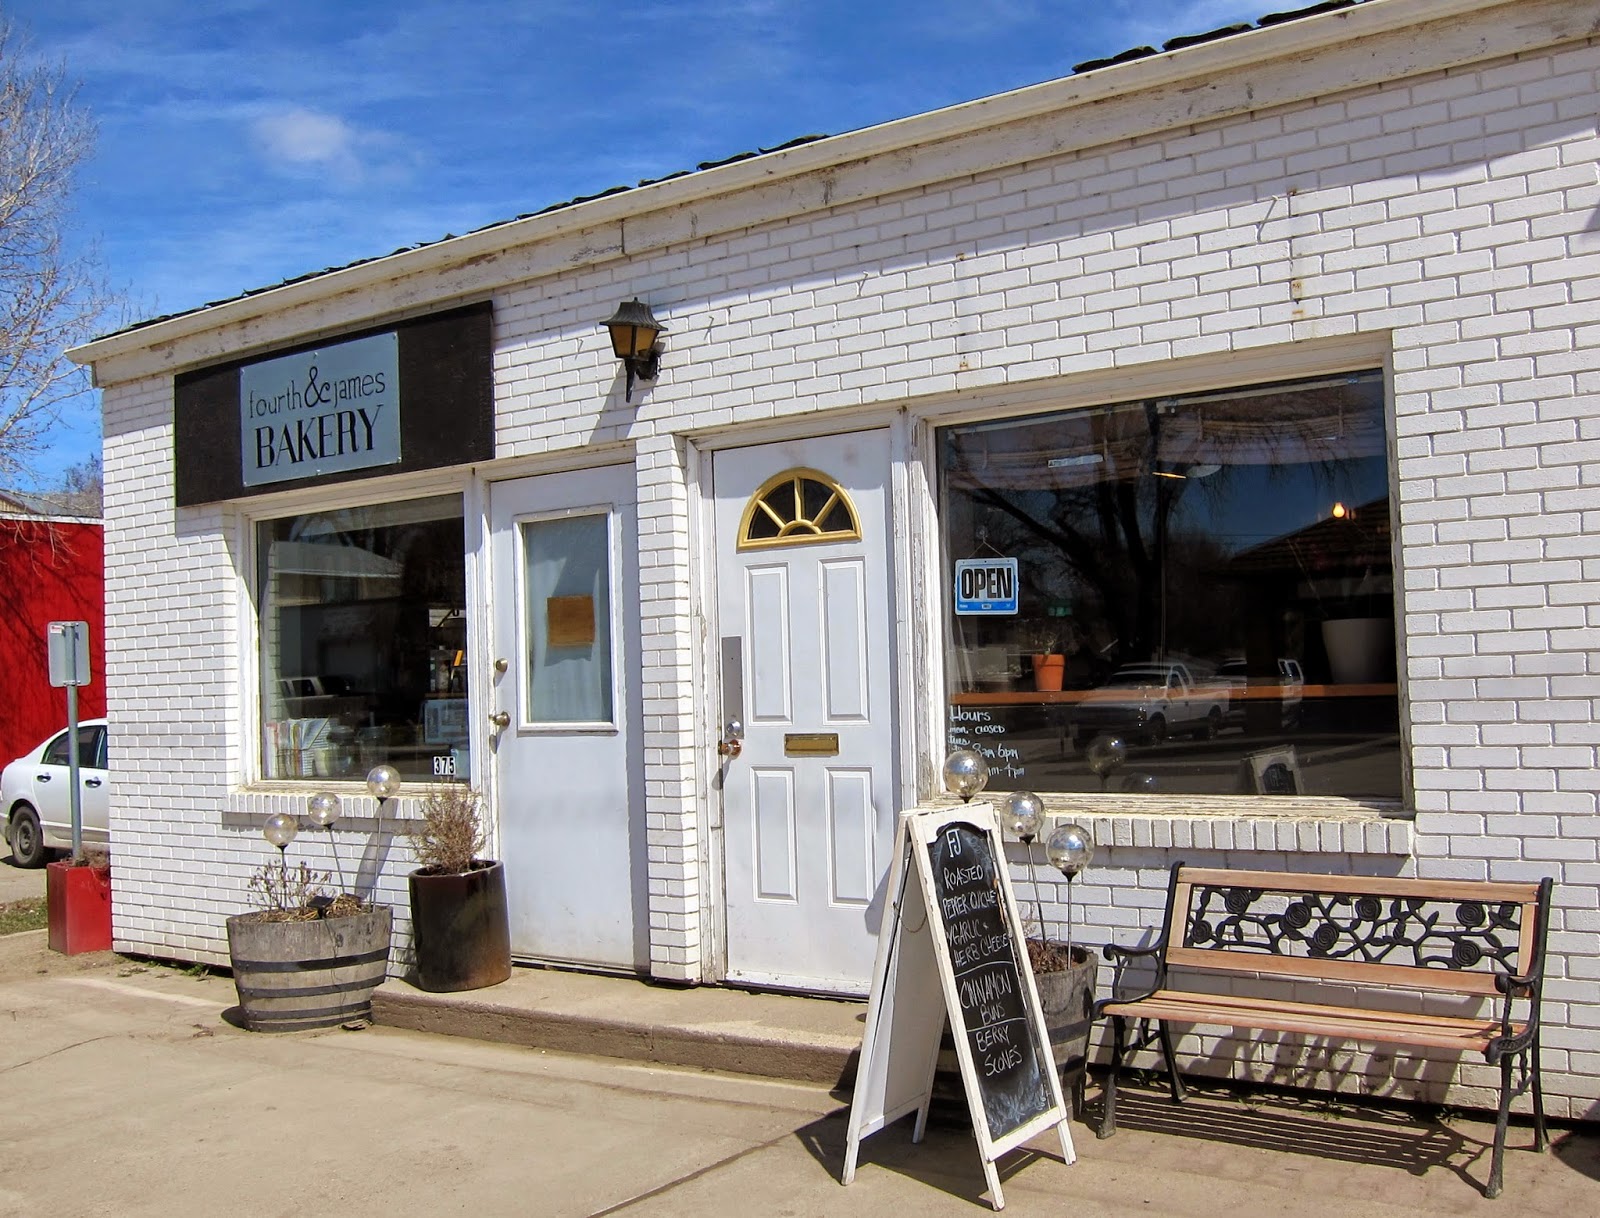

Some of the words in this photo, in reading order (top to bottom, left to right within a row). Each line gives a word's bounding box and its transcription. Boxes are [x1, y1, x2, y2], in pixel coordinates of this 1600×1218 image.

[250, 380, 301, 418] fourth
[304, 366, 331, 408] &
[333, 372, 386, 408] james
[255, 404, 384, 469] BAKERY
[961, 567, 1012, 599] OPEN
[949, 705, 991, 722] Hours
[434, 757, 455, 774] 375
[946, 828, 962, 858] FJ
[943, 864, 984, 891] ROASTED
[953, 943, 981, 968] HERB
[980, 932, 1010, 957] CHEESE
[960, 969, 1012, 1009] CINNAMON
[975, 1025, 1011, 1053] BERRY
[984, 1044, 1023, 1077] SCONES
